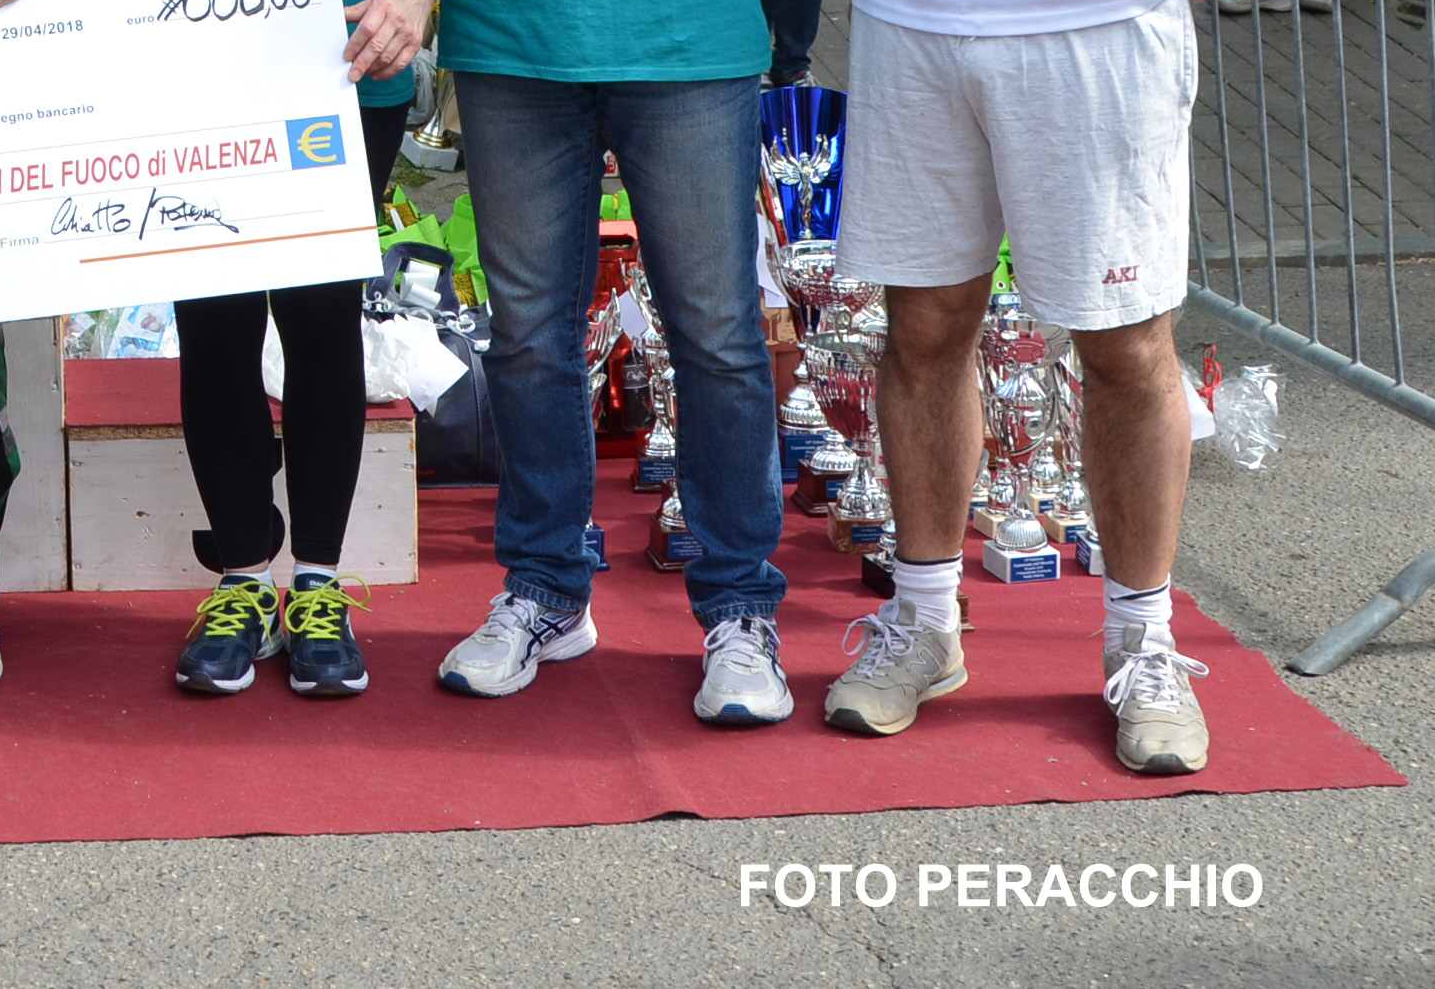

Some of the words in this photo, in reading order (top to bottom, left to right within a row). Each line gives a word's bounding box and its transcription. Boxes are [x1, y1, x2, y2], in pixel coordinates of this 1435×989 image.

[126, 13, 155, 26] euro
[0, 18, 84, 41] 29/04/2018
[36, 103, 95, 119] bancario
[10, 162, 54, 194] DEL
[60, 152, 141, 188] FUOCO
[147, 150, 166, 177] di
[173, 137, 279, 174] VALENZA
[0, 234, 40, 249] Firma
[1101, 265, 1140, 285] AKI
